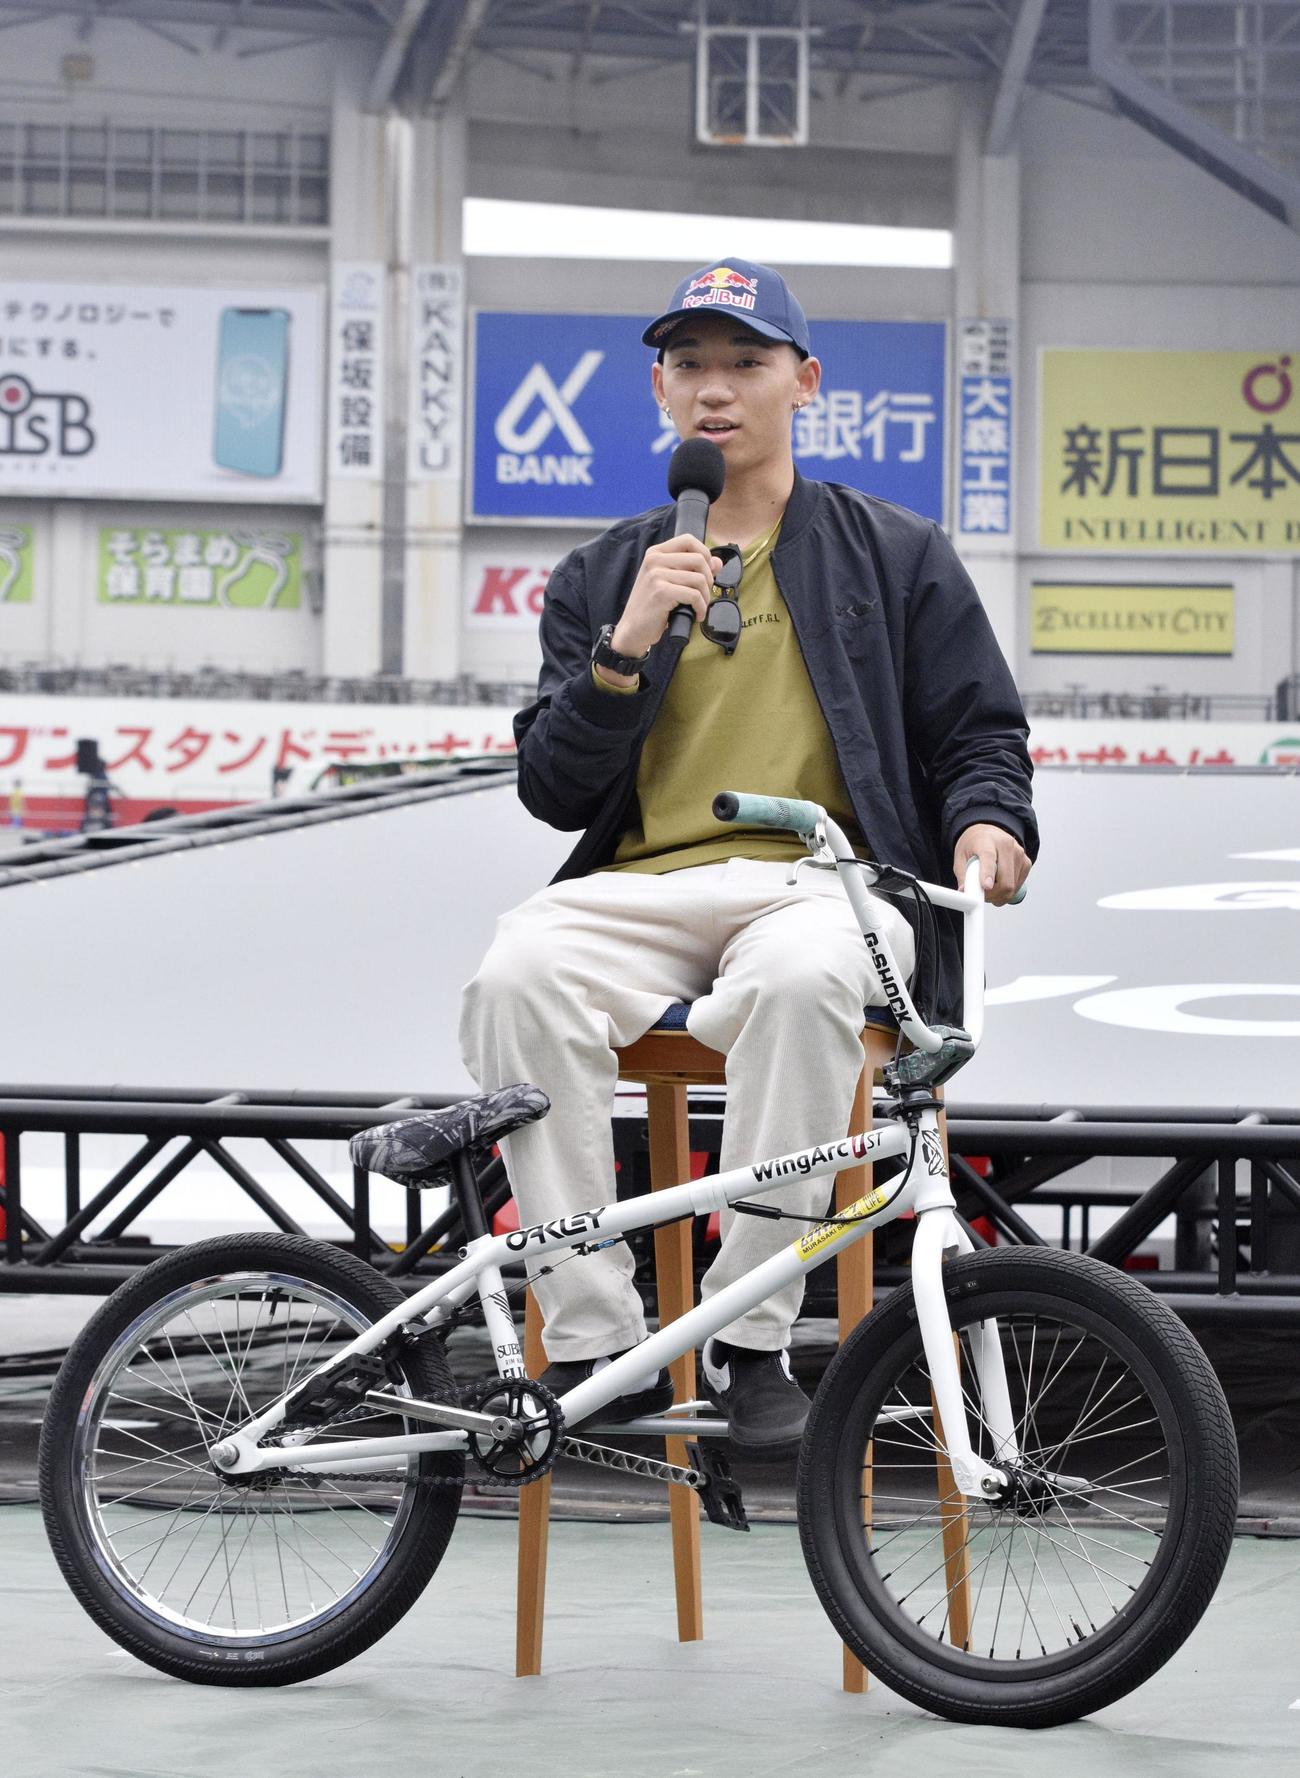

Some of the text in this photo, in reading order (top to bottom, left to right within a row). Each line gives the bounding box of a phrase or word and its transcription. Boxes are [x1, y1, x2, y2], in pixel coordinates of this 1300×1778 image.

[683, 289, 755, 310] Red Bull
[0, 337, 96, 359] にする。
[496, 454, 594, 486] BANK
[1064, 517, 1266, 542] INTELLIGENT
[864, 932, 913, 1024] G-SHOCK
[506, 1207, 606, 1251] OAKLEY
[497, 1343, 521, 1358] SUB
